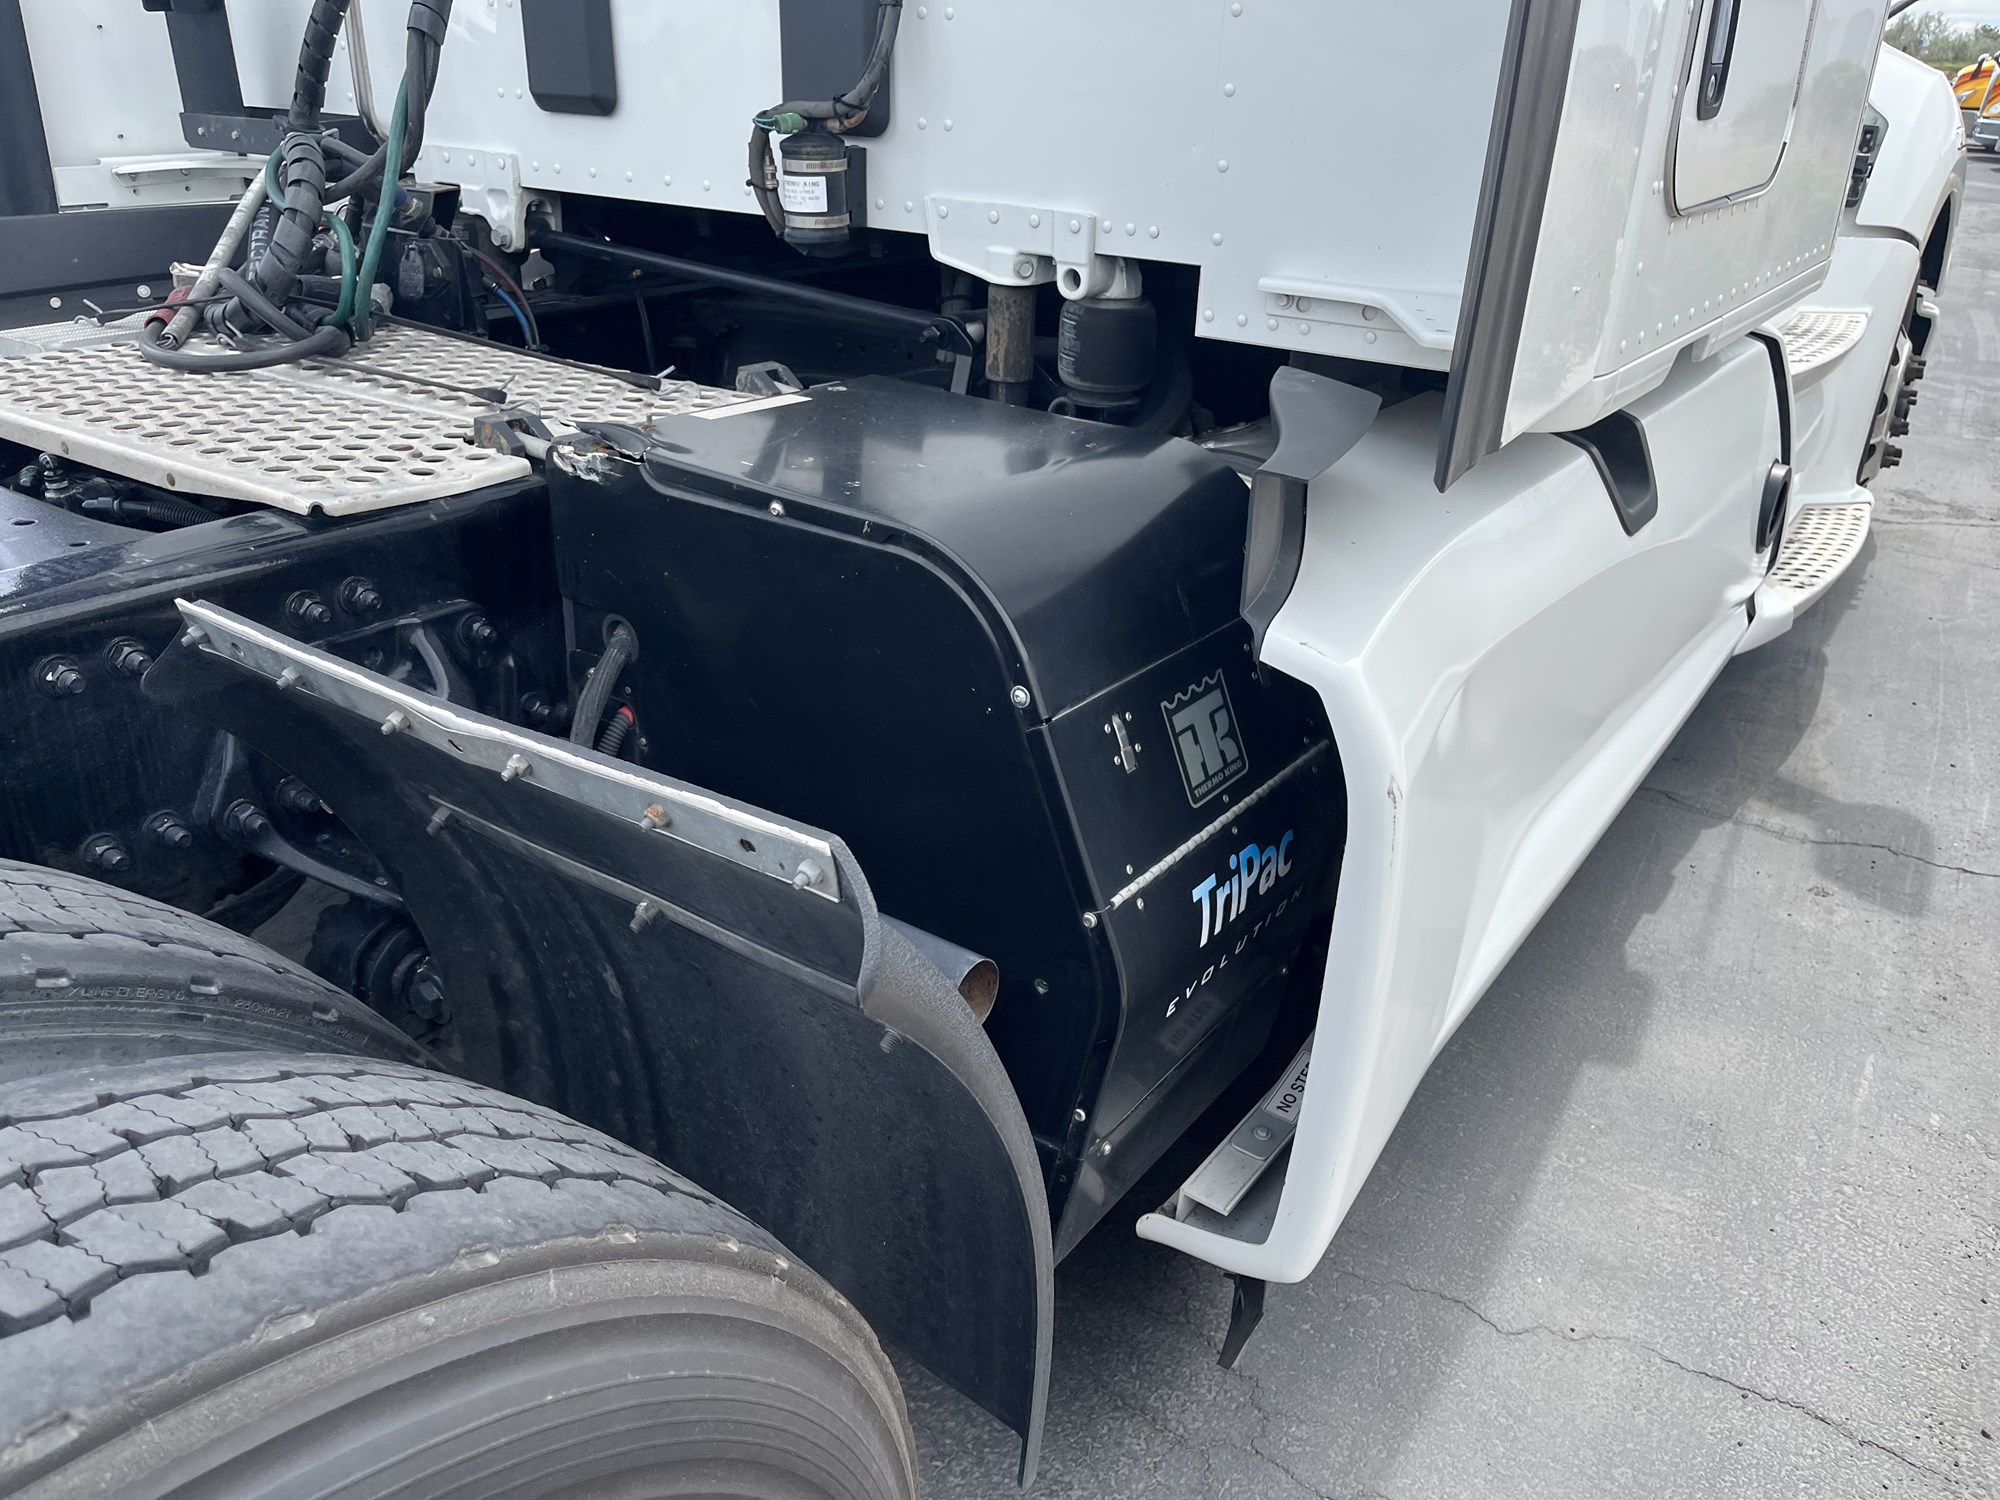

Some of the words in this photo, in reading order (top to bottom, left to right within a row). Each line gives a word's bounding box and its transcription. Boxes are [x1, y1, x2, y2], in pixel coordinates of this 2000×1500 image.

[1194, 771, 1224, 798] THERMO
[1223, 760, 1243, 779] KING
[1192, 829, 1294, 948] TriPac
[1165, 883, 1304, 1018] EVOLUTION
[1276, 1093, 1297, 1113] NO
[1290, 1062, 1310, 1093] STE
